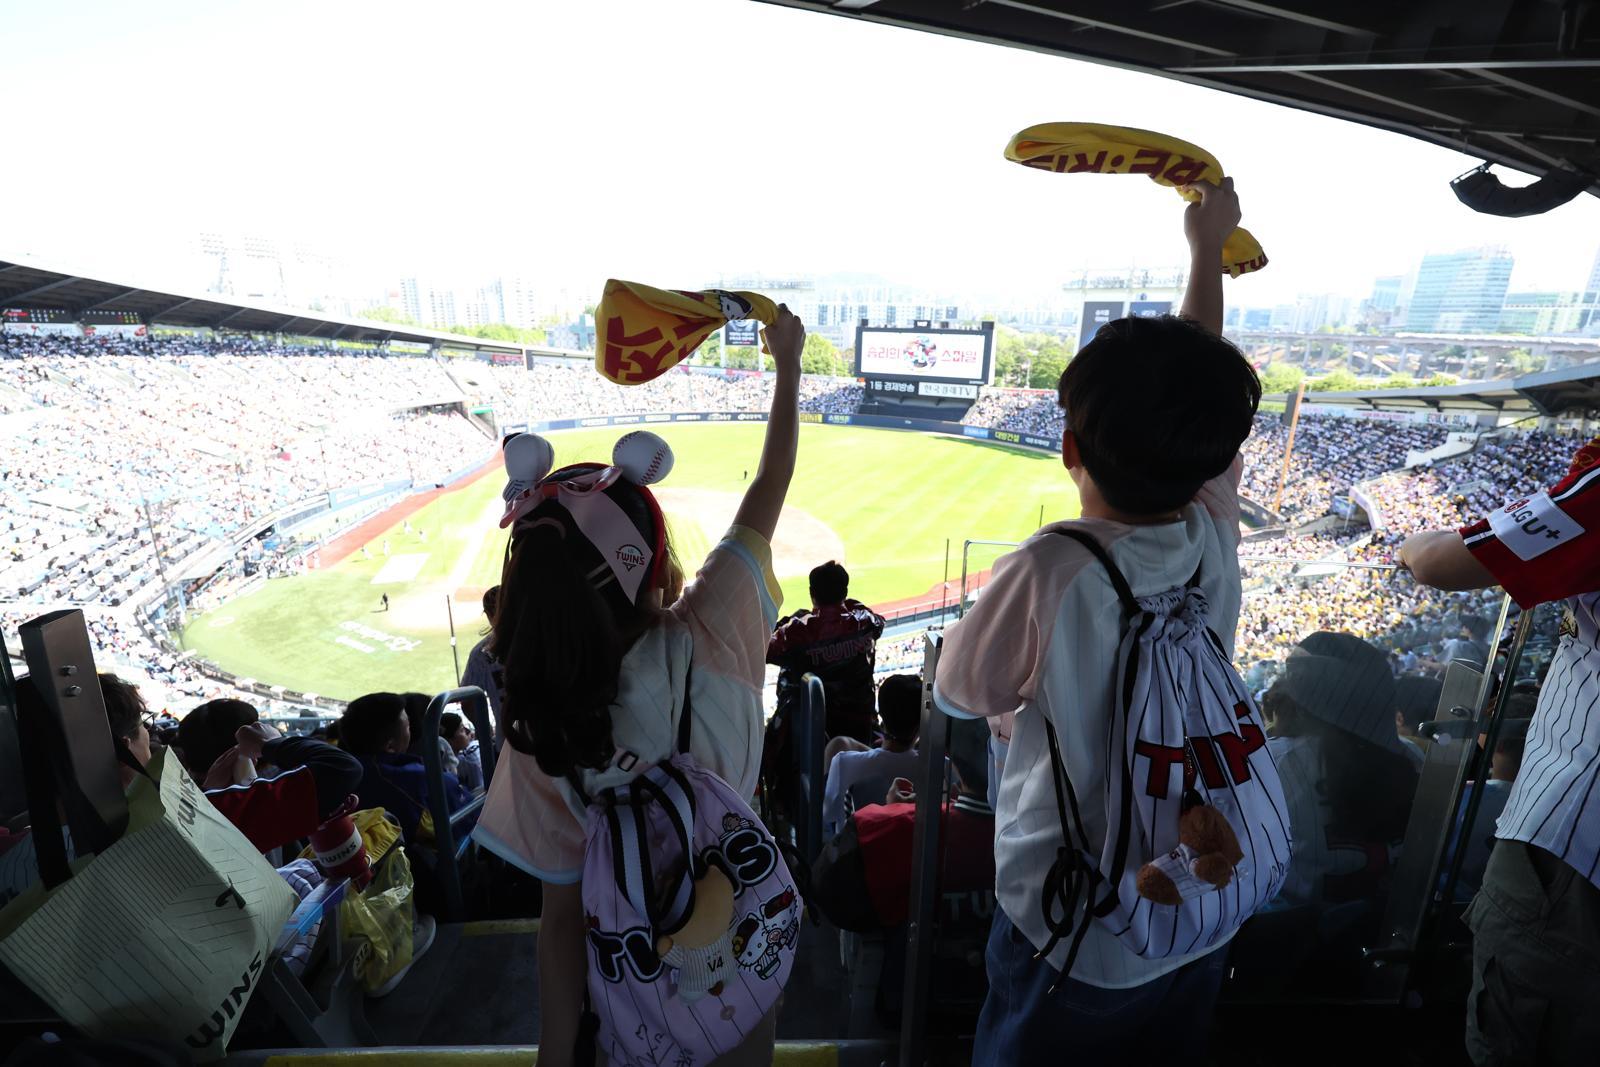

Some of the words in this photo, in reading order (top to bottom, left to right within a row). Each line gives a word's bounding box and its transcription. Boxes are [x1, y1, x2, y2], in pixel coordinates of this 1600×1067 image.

[867, 346, 900, 359] 승리의
[616, 551, 645, 566] TWINS
[321, 842, 356, 864] TWINS
